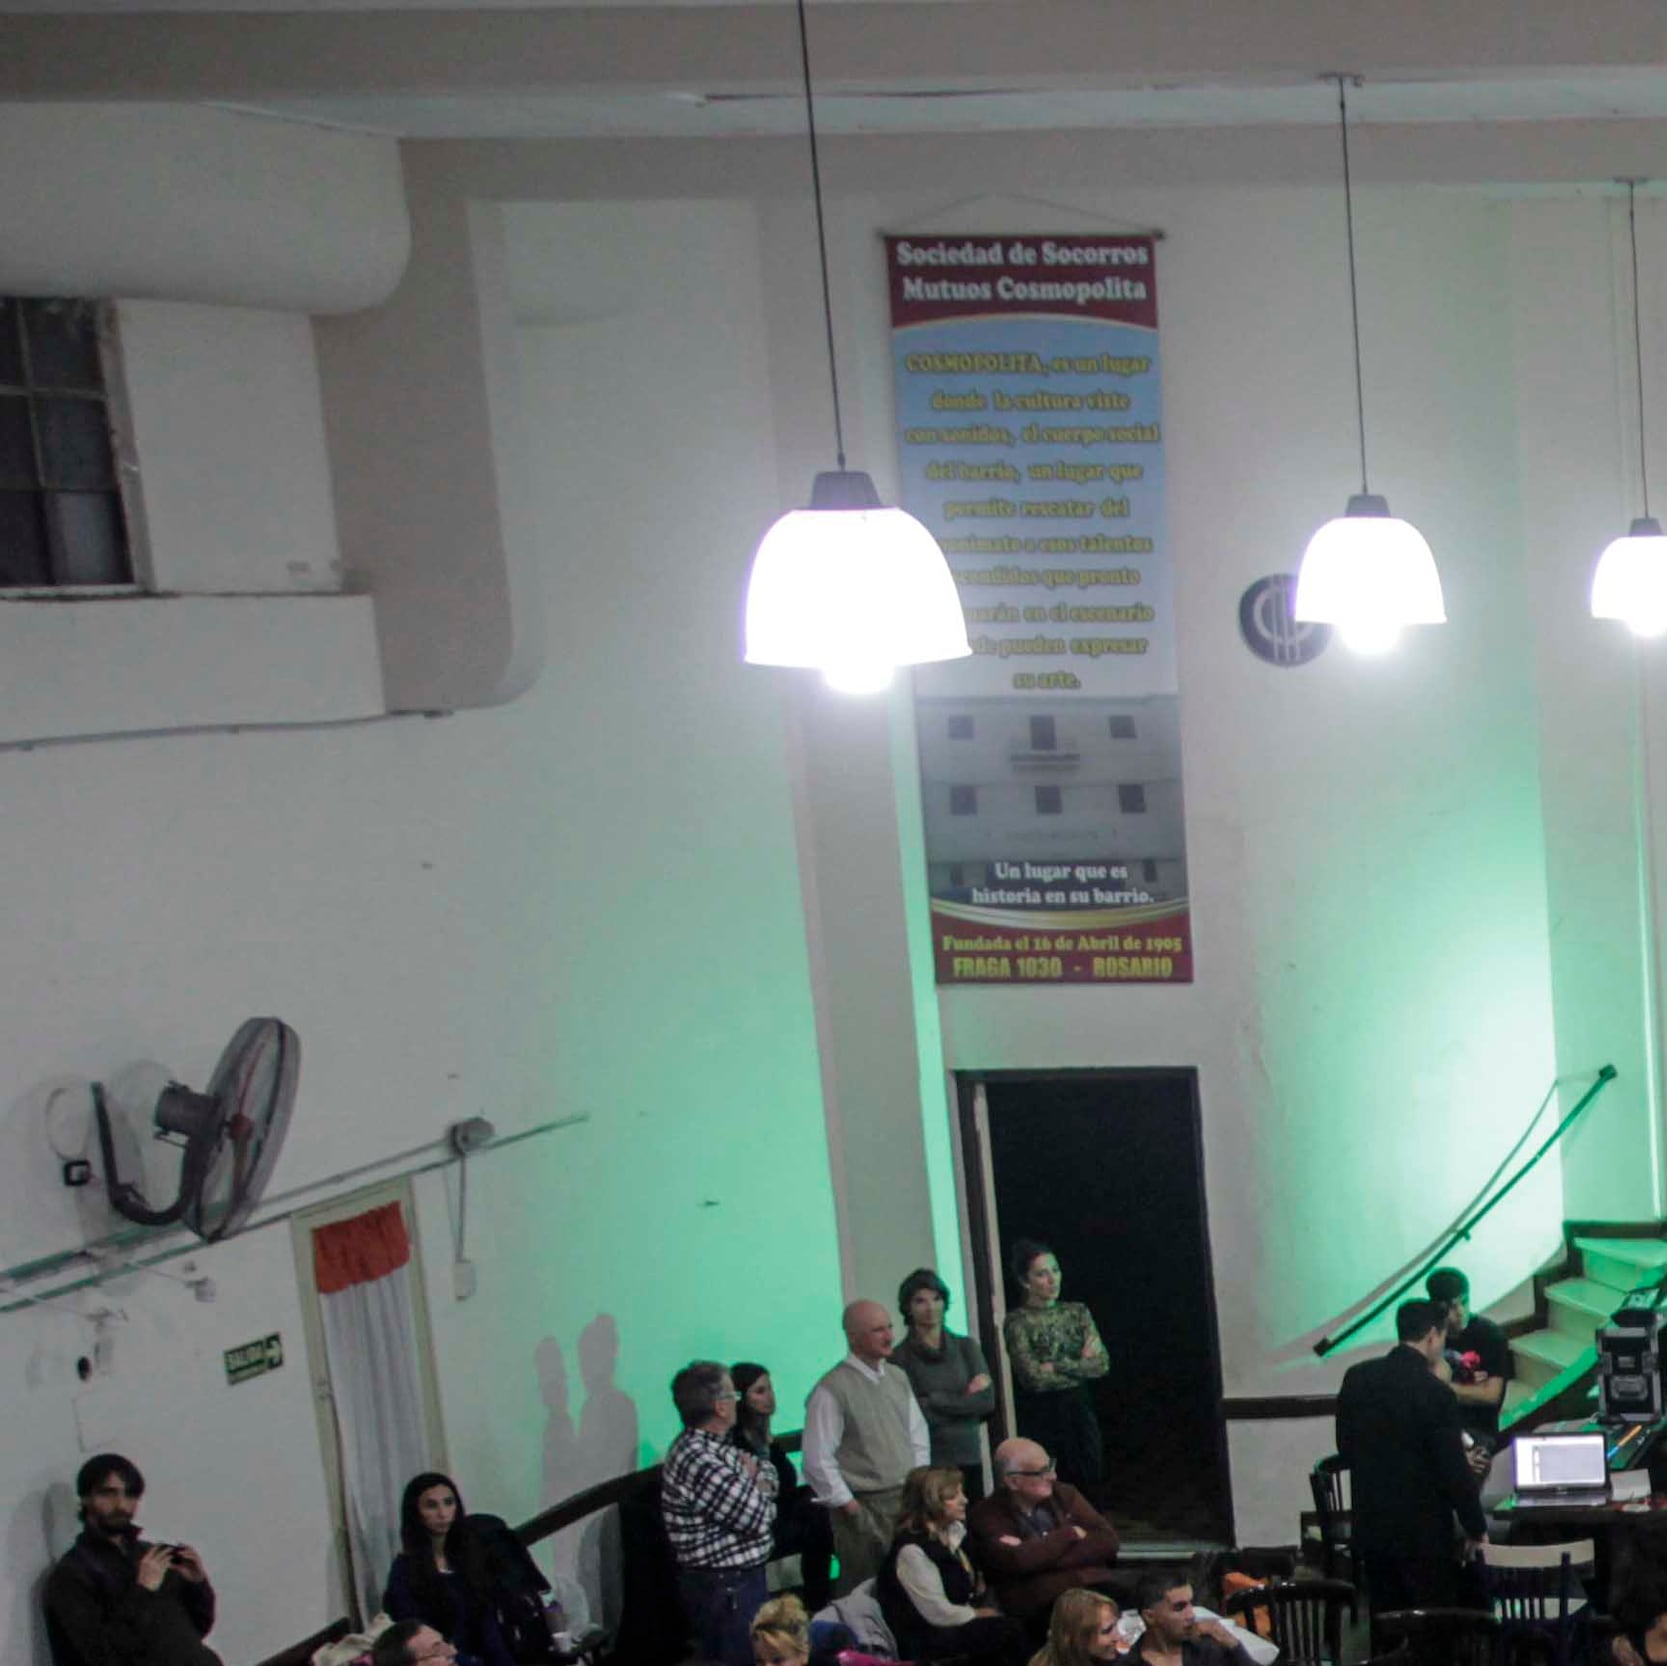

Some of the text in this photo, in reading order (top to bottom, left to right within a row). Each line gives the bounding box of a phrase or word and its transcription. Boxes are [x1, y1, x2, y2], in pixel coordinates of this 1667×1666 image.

[897, 241, 1148, 266] Sociedad de Socorros
[902, 275, 1147, 304] Mutuos Cosmopolita
[906, 353, 1049, 376] COSMOPOLITA,
[1074, 357, 1097, 373] un
[1102, 354, 1149, 376] lugar
[994, 862, 1128, 882] Un lugar que es
[972, 887, 1155, 905] historia en su barrio.
[942, 936, 1011, 952] Fundada
[1015, 935, 1029, 951] el
[1055, 935, 1074, 951] de
[1077, 936, 1120, 951] Abril
[1123, 936, 1142, 950] de
[1147, 937, 1183, 952] 1905
[953, 957, 1011, 977] FRAGA
[1093, 957, 1174, 977] ROSARIO
